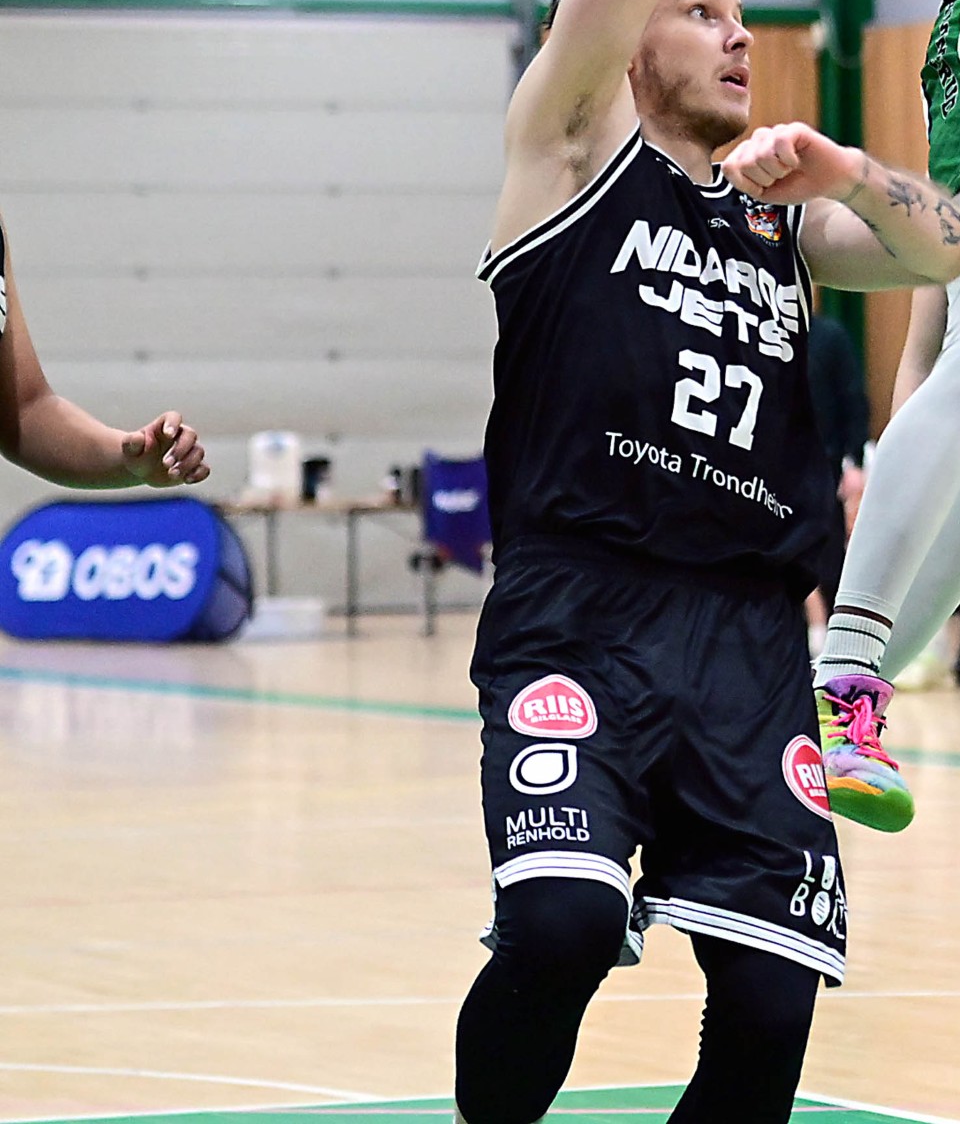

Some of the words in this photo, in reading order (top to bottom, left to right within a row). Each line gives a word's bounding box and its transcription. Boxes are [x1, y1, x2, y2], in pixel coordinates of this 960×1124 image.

[638, 279, 795, 363] JETS
[670, 348, 764, 451] 27
[605, 430, 682, 474] Toyota
[74, 543, 199, 601] OBOS
[523, 694, 585, 720] RIIS
[795, 763, 827, 789] RII
[505, 806, 589, 836] MULTI
[506, 826, 591, 851] RENHOLD
